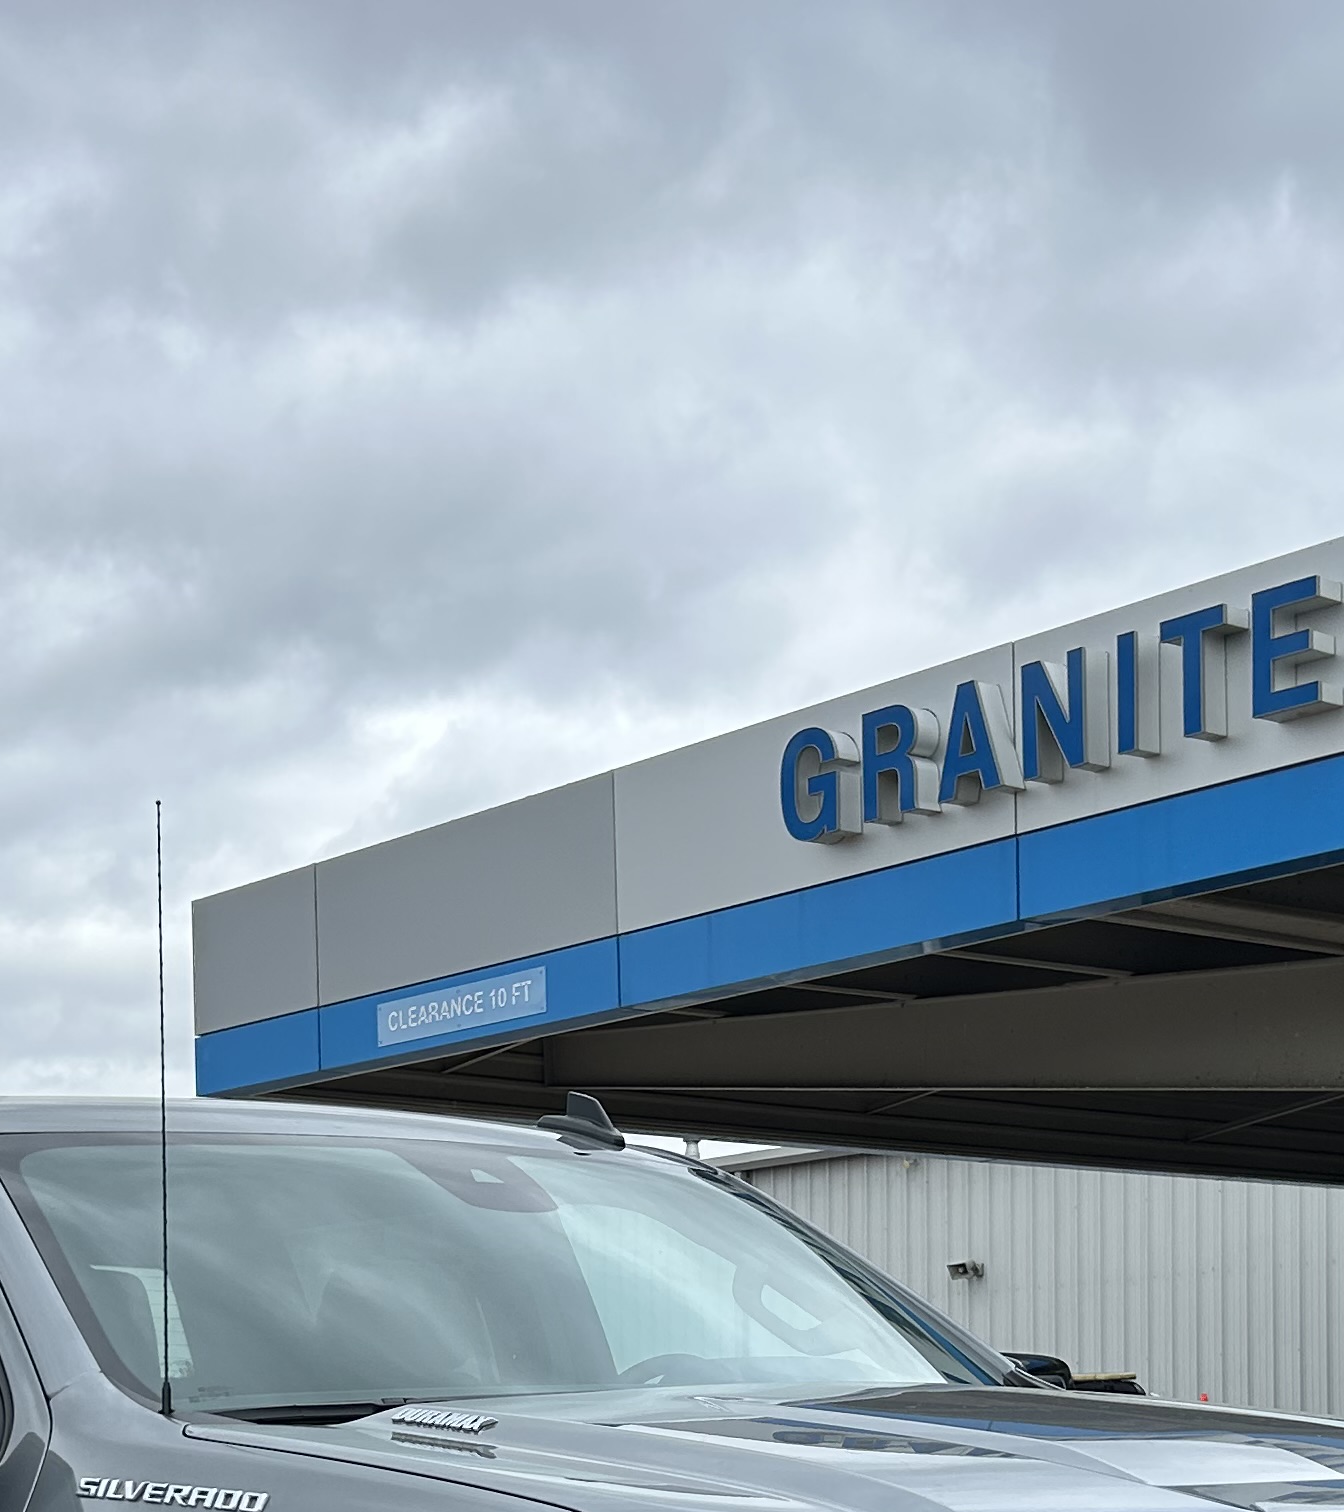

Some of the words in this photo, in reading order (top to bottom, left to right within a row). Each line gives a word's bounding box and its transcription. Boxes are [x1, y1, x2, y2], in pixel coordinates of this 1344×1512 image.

[780, 574, 1342, 843] GRANITE
[387, 991, 484, 1031] CLEARANCE
[488, 988, 507, 1010] 10
[511, 980, 532, 1006] FT
